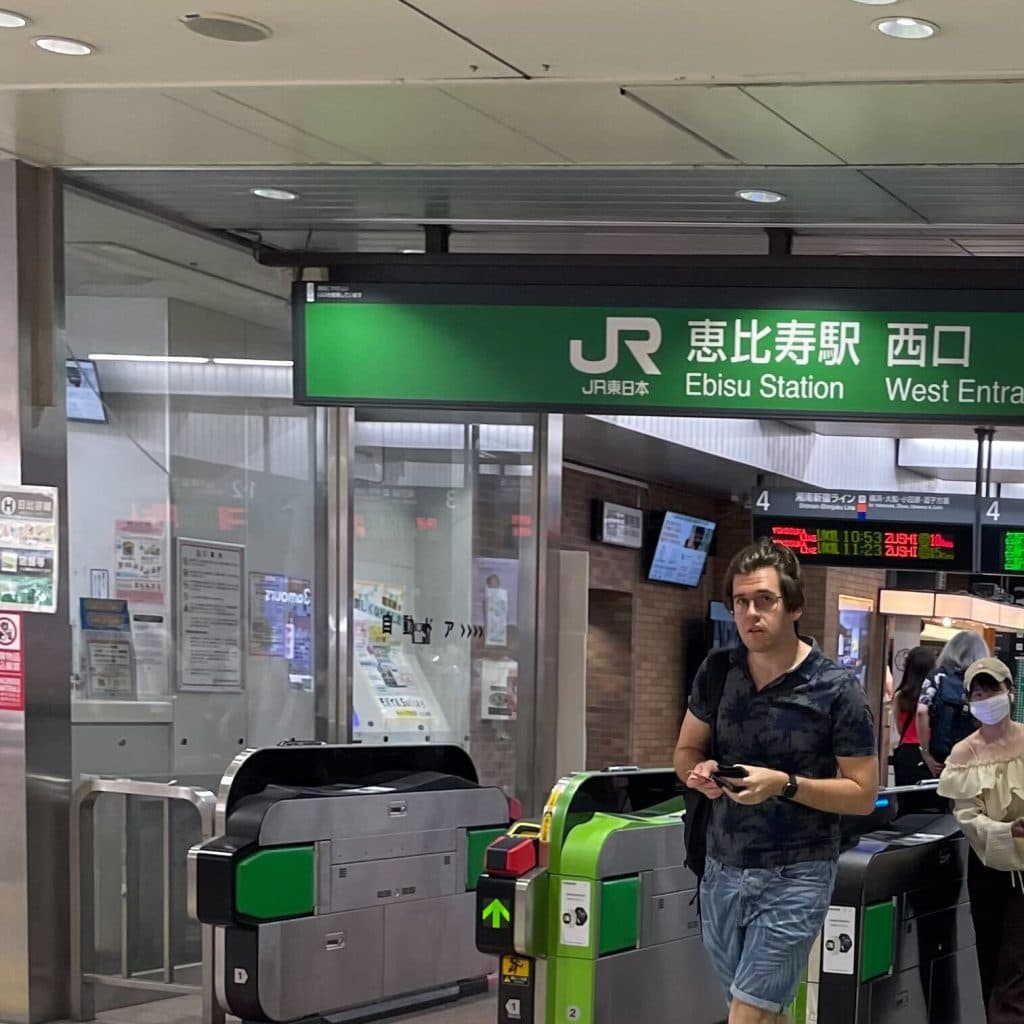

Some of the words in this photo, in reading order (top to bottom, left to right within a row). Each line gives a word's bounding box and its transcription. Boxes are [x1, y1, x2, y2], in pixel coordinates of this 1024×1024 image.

[569, 316, 662, 375] JR
[686, 319, 860, 367] 恵比寿駅
[886, 322, 973, 368] 西口
[581, 379, 650, 397] JR東日本
[685, 372, 753, 398] Ebisu
[759, 374, 844, 400] Station
[885, 378, 949, 404] West
[756, 490, 770, 511] 4
[985, 501, 1001, 521] 4
[843, 530, 882, 544] 10:53
[843, 543, 882, 557] 11:23
[237, 971, 243, 981] 1
[510, 1002, 517, 1012] 1
[569, 1007, 577, 1018] 2
